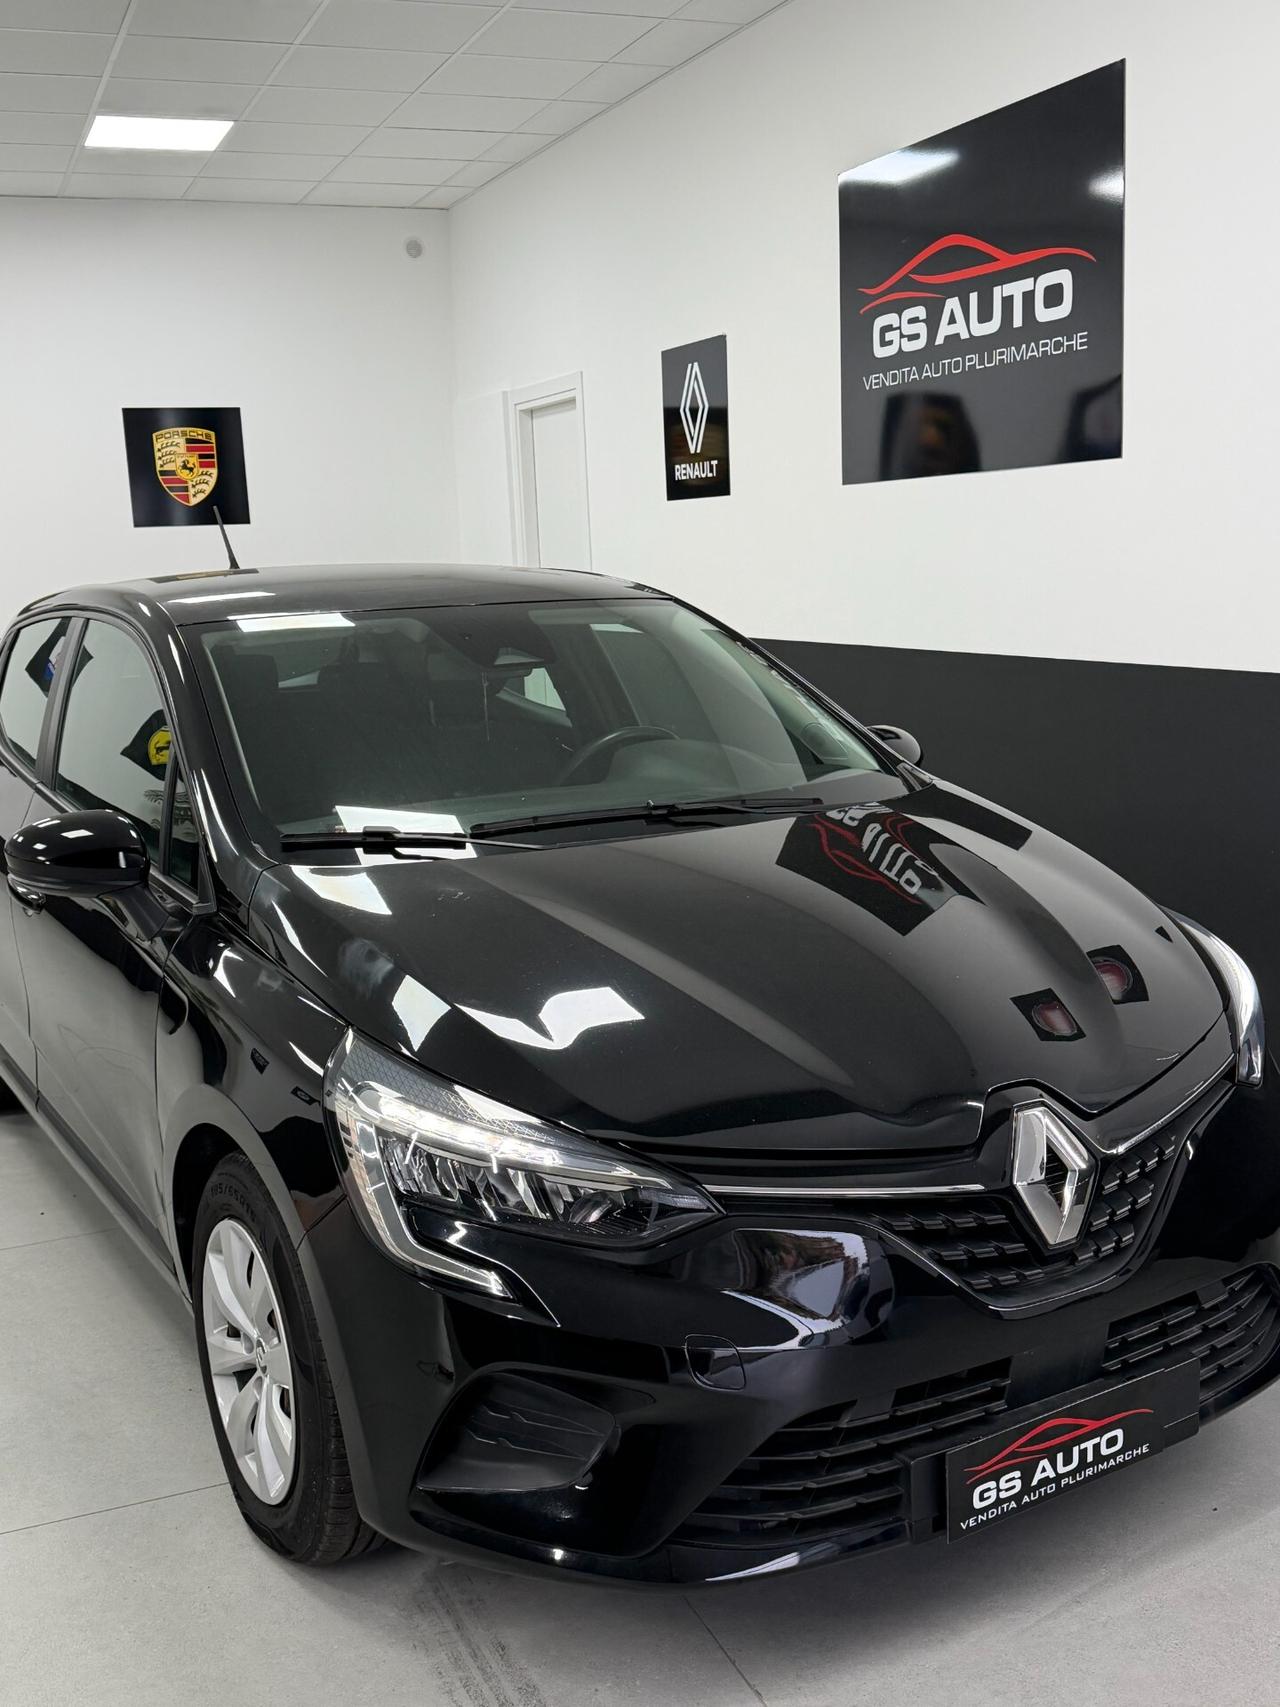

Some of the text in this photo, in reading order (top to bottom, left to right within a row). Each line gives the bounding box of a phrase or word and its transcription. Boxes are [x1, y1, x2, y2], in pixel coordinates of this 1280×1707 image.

[872, 268, 1073, 359] GS AUTO
[862, 331, 1089, 391] VENDITA AUTO PLURIMARCHE
[155, 430, 212, 443] PORSCHE
[674, 459, 719, 481] RENAULT
[960, 1443, 1151, 1531] VENDITA AUTO PLURIMARCHE
[972, 1428, 1125, 1510] GS AUTO
